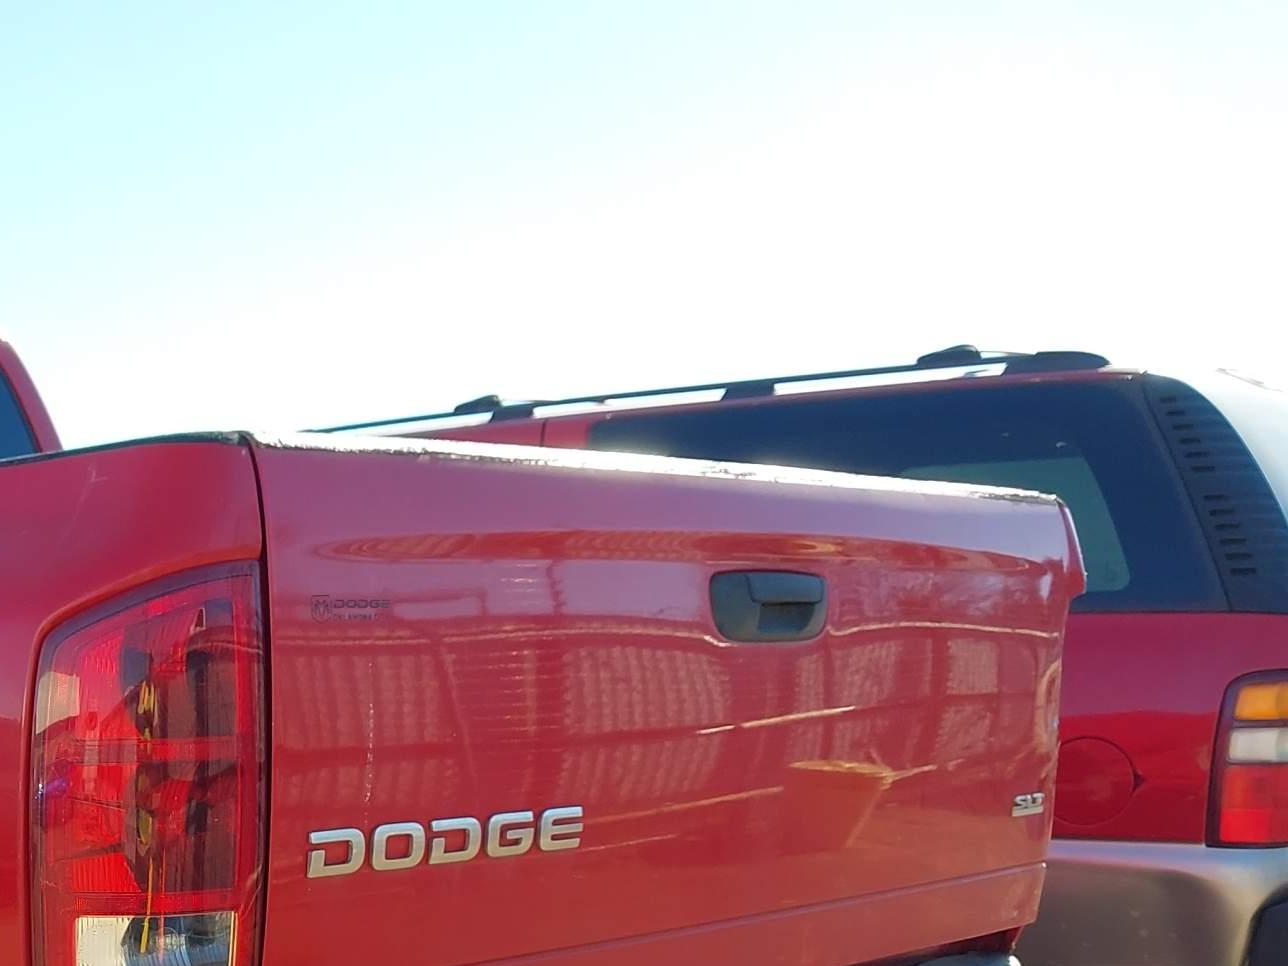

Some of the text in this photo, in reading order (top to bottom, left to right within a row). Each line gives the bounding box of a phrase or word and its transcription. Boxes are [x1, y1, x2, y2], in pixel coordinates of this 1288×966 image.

[333, 599, 391, 609] DODGE
[1014, 792, 1045, 809] SLT
[307, 805, 584, 879] DODGE
